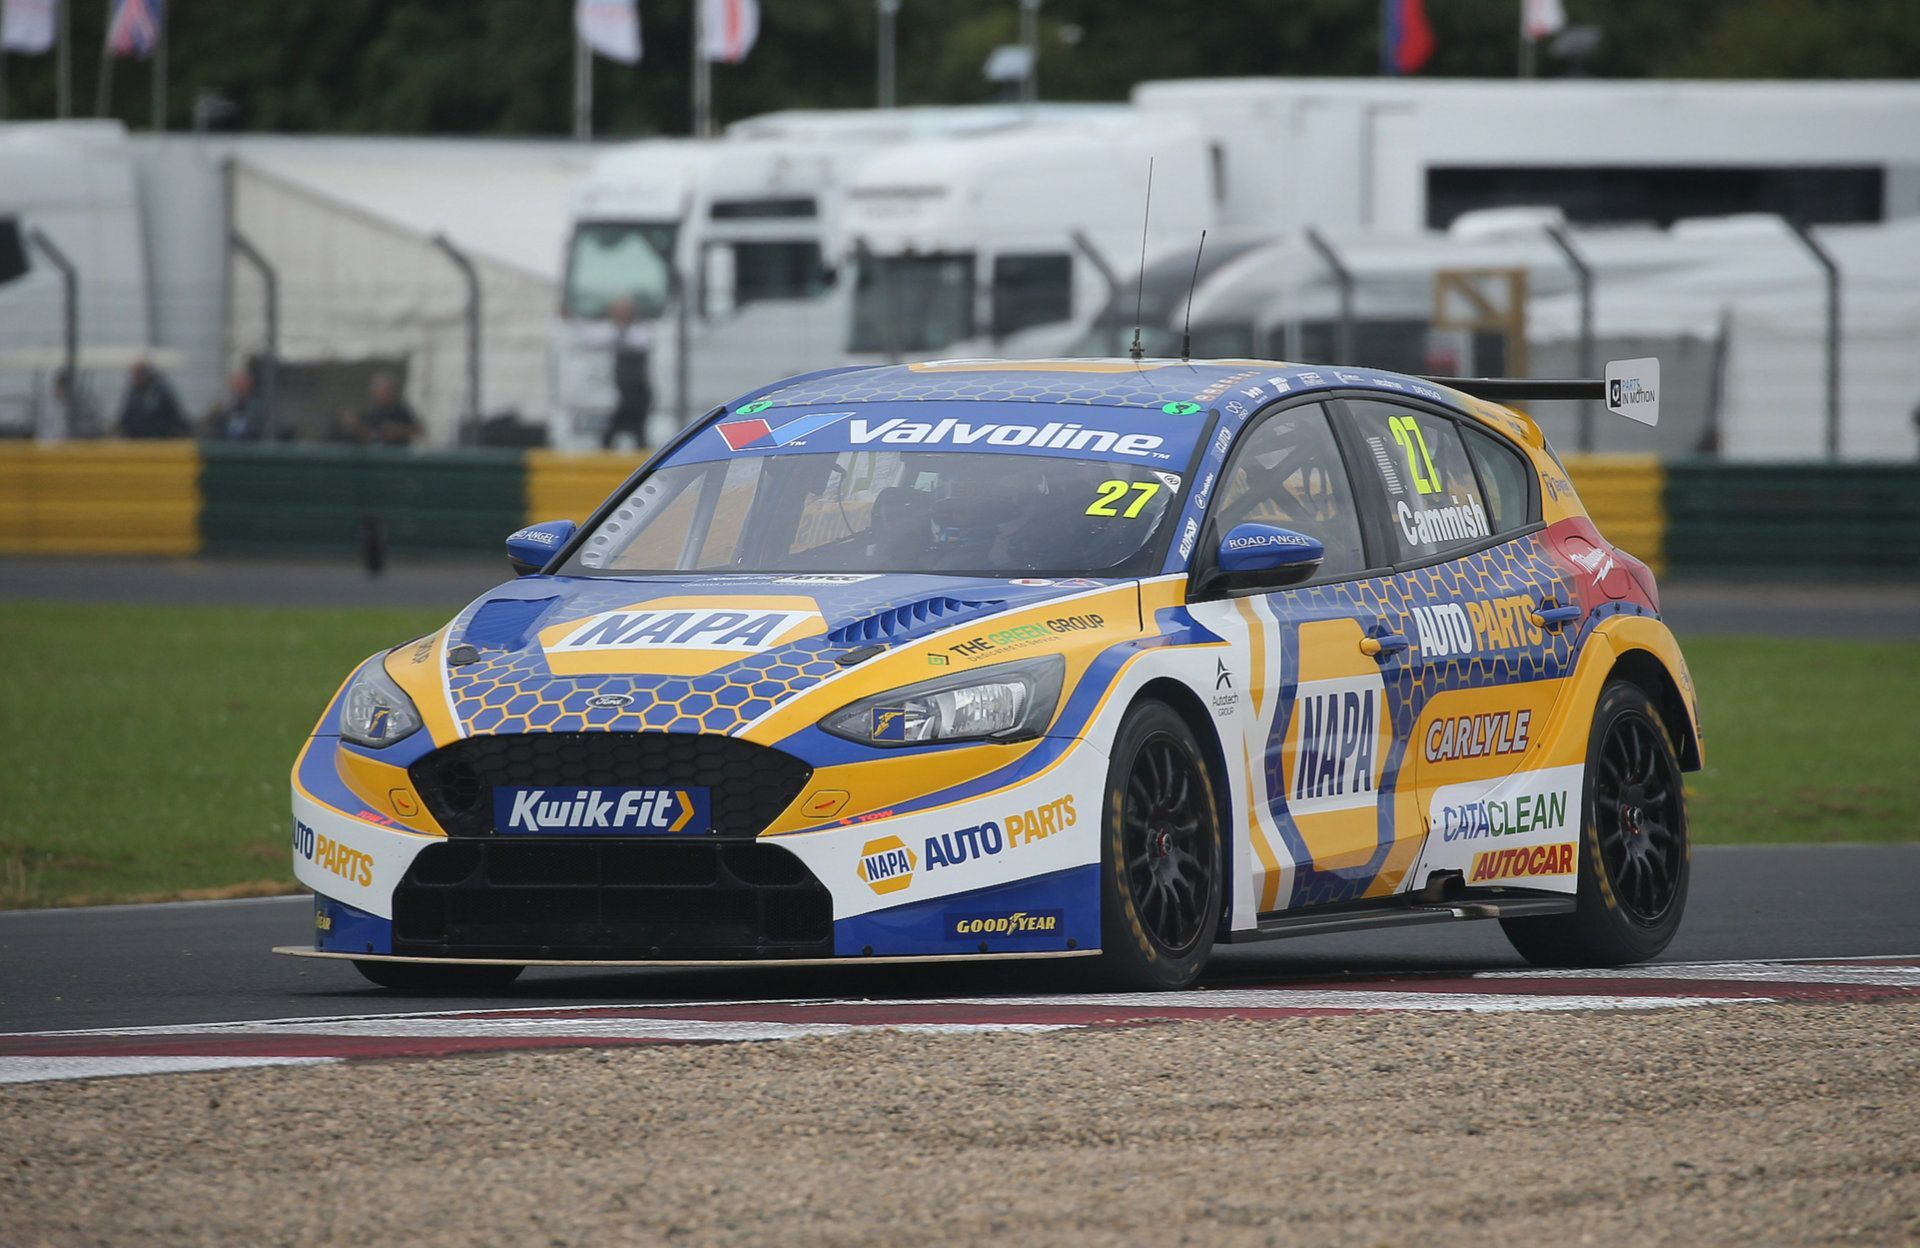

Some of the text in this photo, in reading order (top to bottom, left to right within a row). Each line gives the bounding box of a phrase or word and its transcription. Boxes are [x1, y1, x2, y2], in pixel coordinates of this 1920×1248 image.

[1621, 378, 1640, 391] PARTS
[1622, 389, 1655, 404] IN MOTION
[849, 418, 1165, 457] Valvoline
[1388, 415, 1442, 495] 27
[1084, 479, 1160, 518] 27
[1397, 493, 1490, 546] Cammish
[1229, 534, 1309, 549] ROAD ANGEL
[568, 612, 789, 647] NAPA
[950, 613, 1104, 660] THE GREEN GROUP
[1412, 594, 1544, 658] AUTO PARTS
[1212, 692, 1239, 706] Autotech
[1296, 689, 1375, 800] NAPA
[1425, 709, 1532, 764] CARLYLE
[859, 809, 896, 823] TOW
[865, 793, 1077, 882] NAPA AUTO PARTS
[1442, 789, 1568, 843] CATACLEAN
[315, 832, 375, 888] PARTS
[1471, 843, 1574, 883] AUTOCAR
